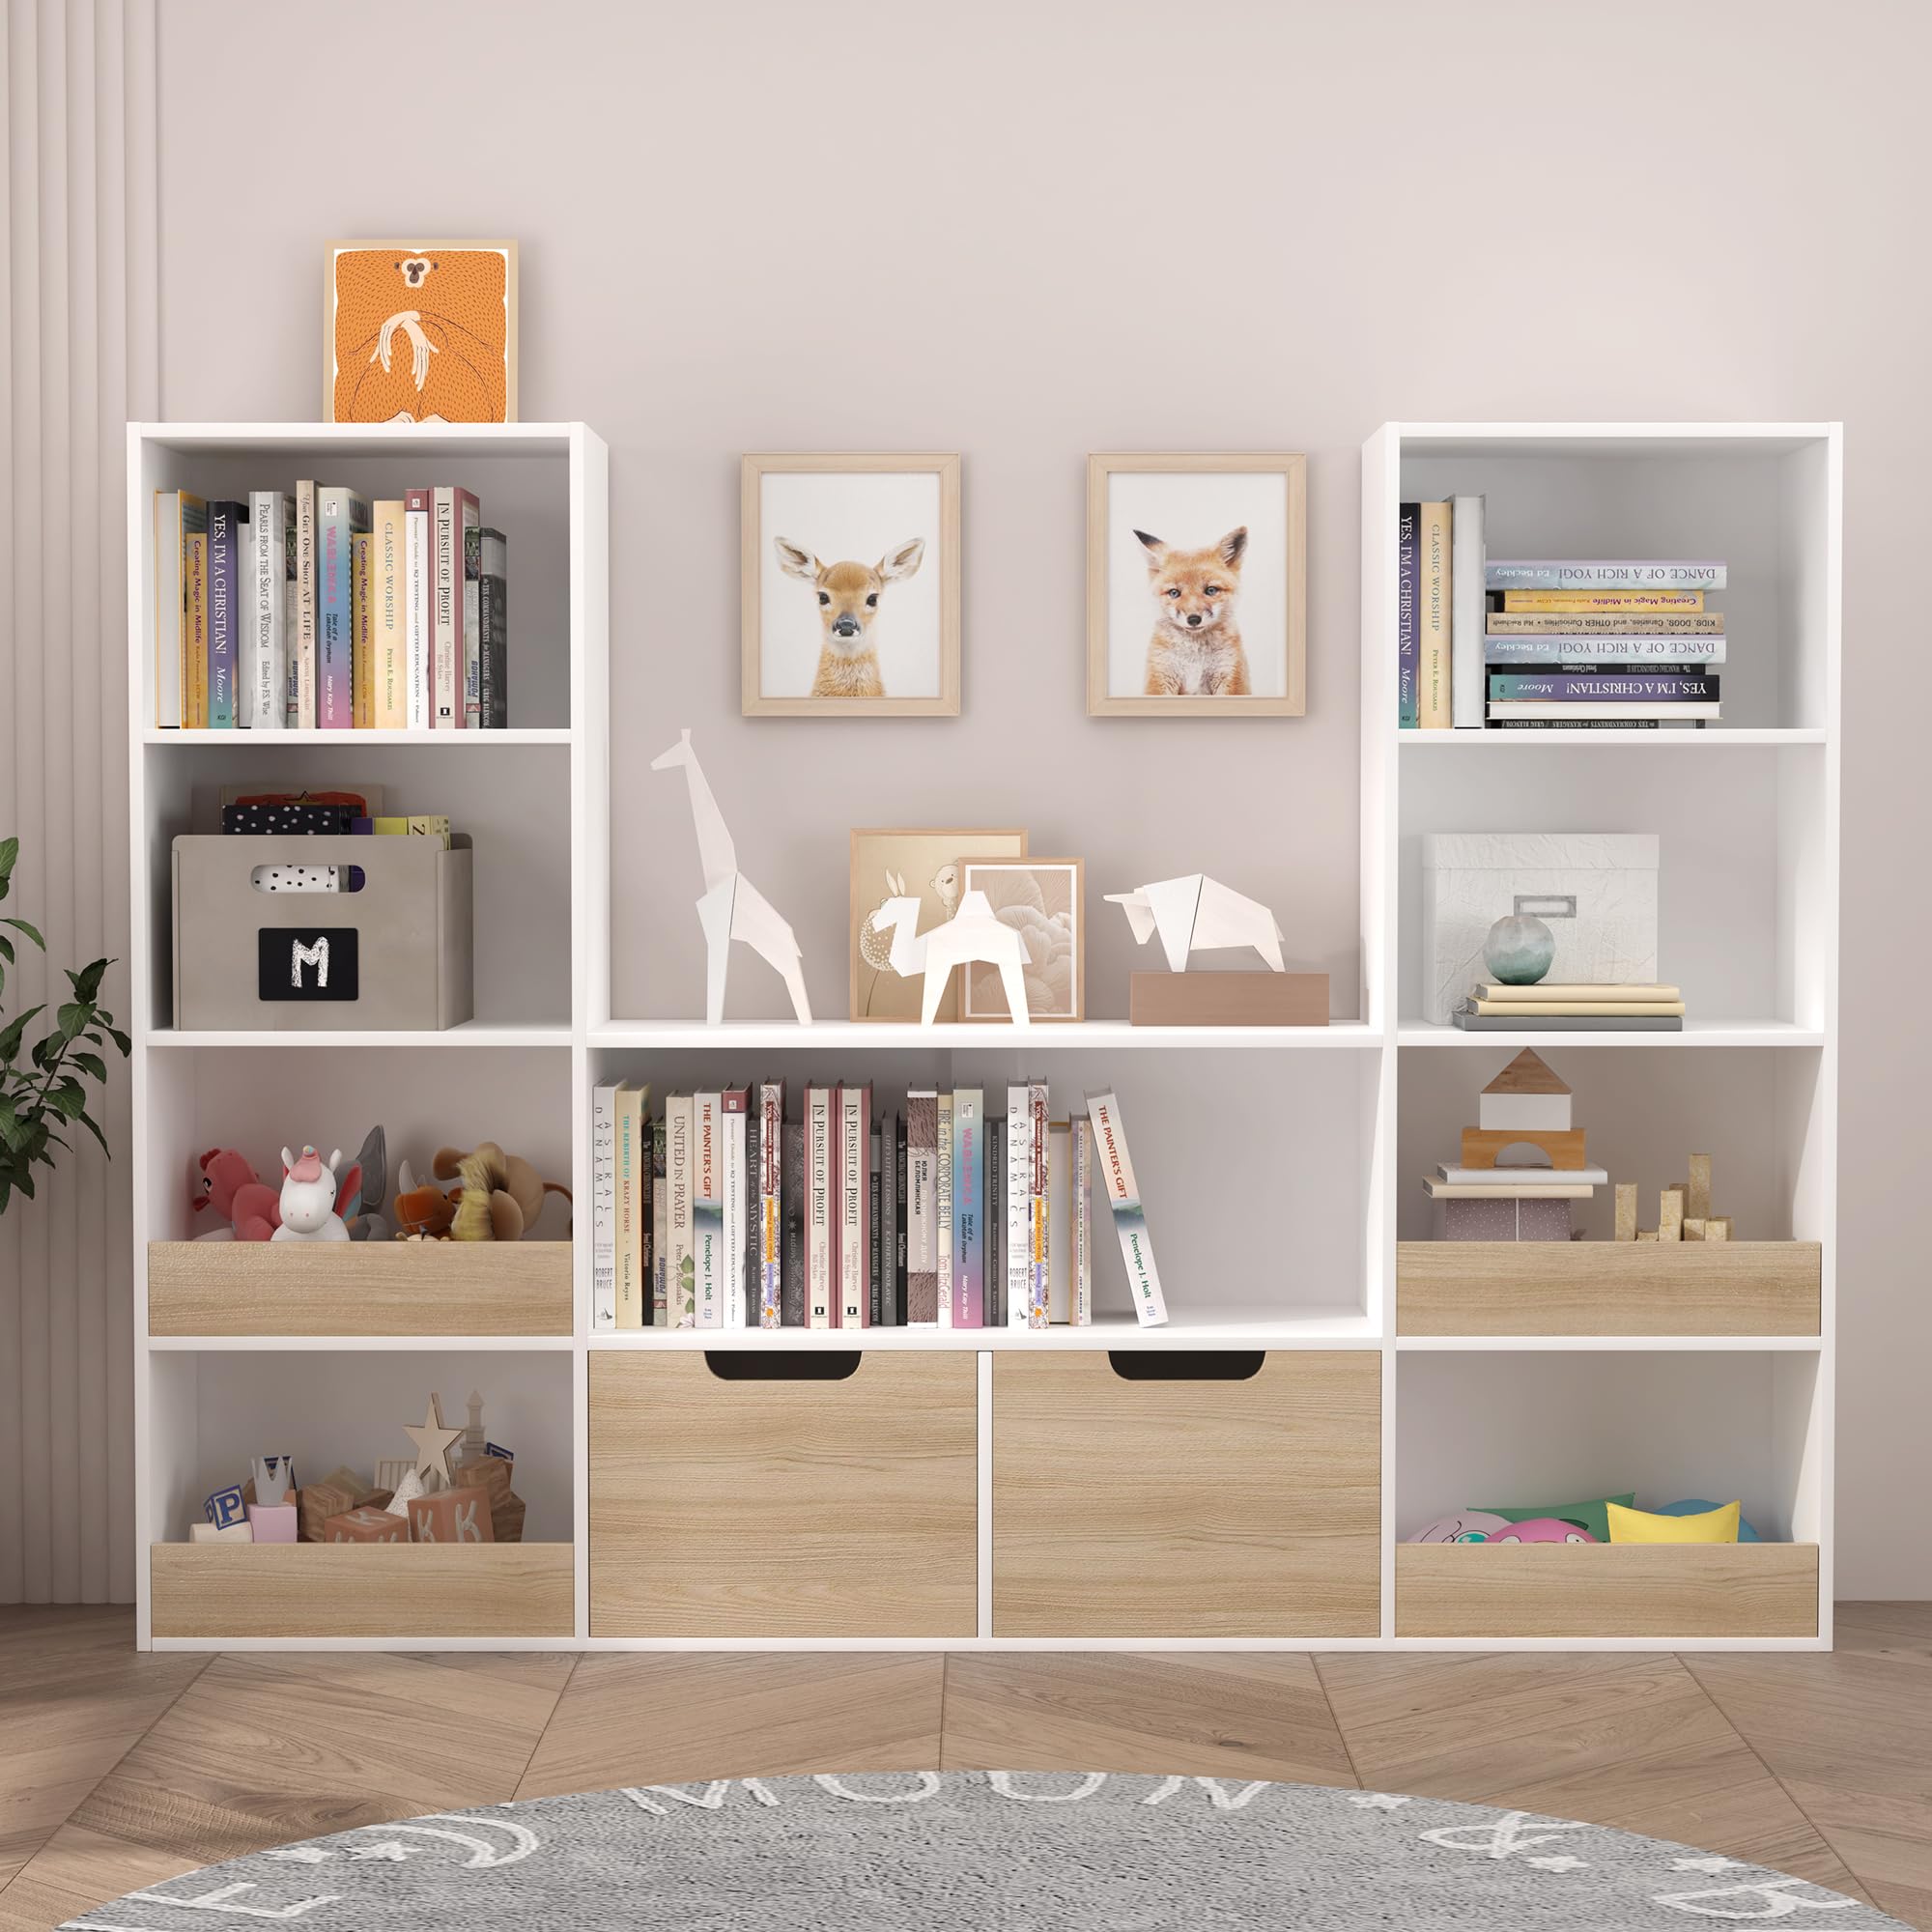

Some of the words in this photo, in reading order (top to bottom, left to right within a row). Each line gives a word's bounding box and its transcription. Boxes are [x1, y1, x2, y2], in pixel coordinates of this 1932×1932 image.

[213, 514, 226, 542] YES,
[1400, 516, 1412, 543] YES,
[260, 535, 269, 557] FROM
[438, 519, 450, 566] PURSUIT
[214, 544, 226, 564] I'M
[1401, 546, 1412, 565] I'M
[214, 566, 226, 577] A
[260, 559, 269, 576] THE
[440, 568, 450, 582] OF
[1401, 568, 1412, 578] A
[1495, 568, 1533, 577] Beckley
[1559, 569, 1592, 579] YOGI
[1598, 569, 1628, 579] RICH
[1634, 569, 1642, 579] A
[1647, 569, 1665, 579] OF
[1670, 569, 1715, 579] DANCE
[260, 577, 271, 598] SEAT
[303, 589, 310, 604] AT
[261, 600, 270, 611] OF
[439, 586, 450, 626] PROFIT
[214, 578, 227, 655] CHRISTIAN!
[1401, 580, 1412, 655] CHRISTIAN!
[1630, 618, 1663, 627] Canaries,
[261, 611, 271, 649] WISDOM
[1495, 642, 1533, 651] Beckley
[1559, 643, 1591, 653] YOGI
[1597, 643, 1627, 653] RICH
[1634, 643, 1641, 653] A
[1646, 643, 1664, 653] OF
[1670, 643, 1715, 653] DANCE
[262, 661, 270, 680] Edited
[216, 667, 226, 703] Moore
[1402, 668, 1410, 703] Moore
[1518, 684, 1553, 693] Moore
[1567, 682, 1643, 694] CHRISTIAN!
[1645, 683, 1655, 694] A
[1658, 683, 1677, 694] I'M
[1680, 681, 1707, 694] YES,
[262, 701, 270, 716] Wise
[291, 936, 329, 988] M
[939, 1110, 951, 1125] FIRE
[1098, 1105, 1110, 1125] THE
[674, 1116, 685, 1167] UNITED
[939, 1128, 951, 1137] in
[813, 1121, 825, 1166] PURSUIT
[846, 1121, 858, 1166] PURSUIT
[939, 1140, 951, 1151] the
[1103, 1126, 1122, 1176] PAINTER'S
[623, 1168, 630, 1179] OF
[674, 1169, 683, 1179] IN
[816, 1169, 825, 1183] OF
[849, 1169, 858, 1183] OF
[1009, 1106, 1018, 1228] DYNAMICS
[939, 1153, 951, 1203] CORPORATE
[1116, 1177, 1127, 1199] GIFT
[674, 1183, 685, 1230] PRAYER
[813, 1188, 825, 1227] PROFIT
[846, 1188, 858, 1227] PROFIT
[939, 1206, 951, 1231] BELLY
[703, 1235, 712, 1272] Penelope
[939, 1254, 950, 1270] Tom
[1130, 1234, 1145, 1271] Penelope
[1142, 1280, 1151, 1299] Holt
[817, 1270, 826, 1292] Harvey
[850, 1270, 859, 1292] Harvey
[939, 1273, 950, 1309] FitzGerald
[215, 1492, 241, 1524] P
[455, 1499, 483, 1543] K
